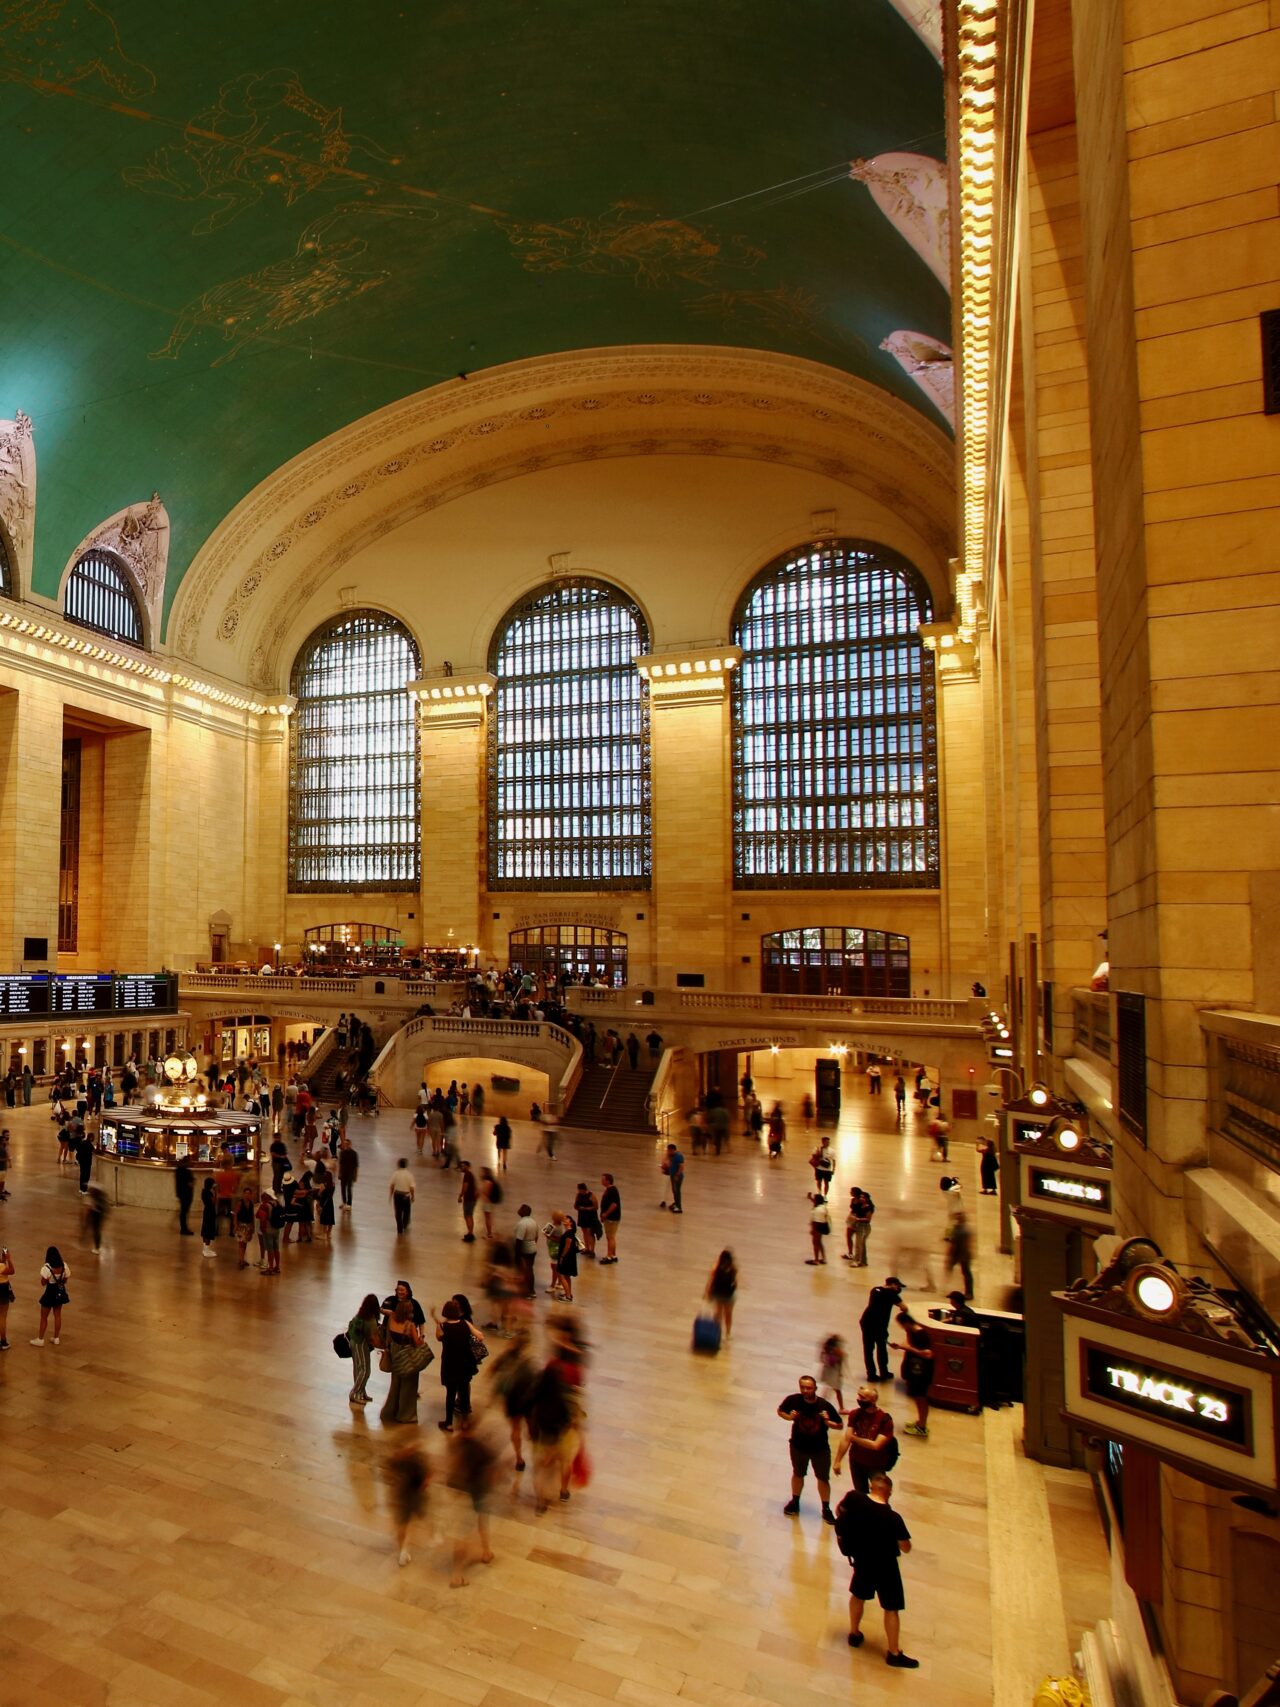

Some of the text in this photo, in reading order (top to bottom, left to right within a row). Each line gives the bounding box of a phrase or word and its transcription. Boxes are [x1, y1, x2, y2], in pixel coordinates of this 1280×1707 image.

[718, 1039, 746, 1047] TICKET
[1042, 1180, 1084, 1197] TRACK
[1107, 1367, 1229, 1422] TRACK 23
